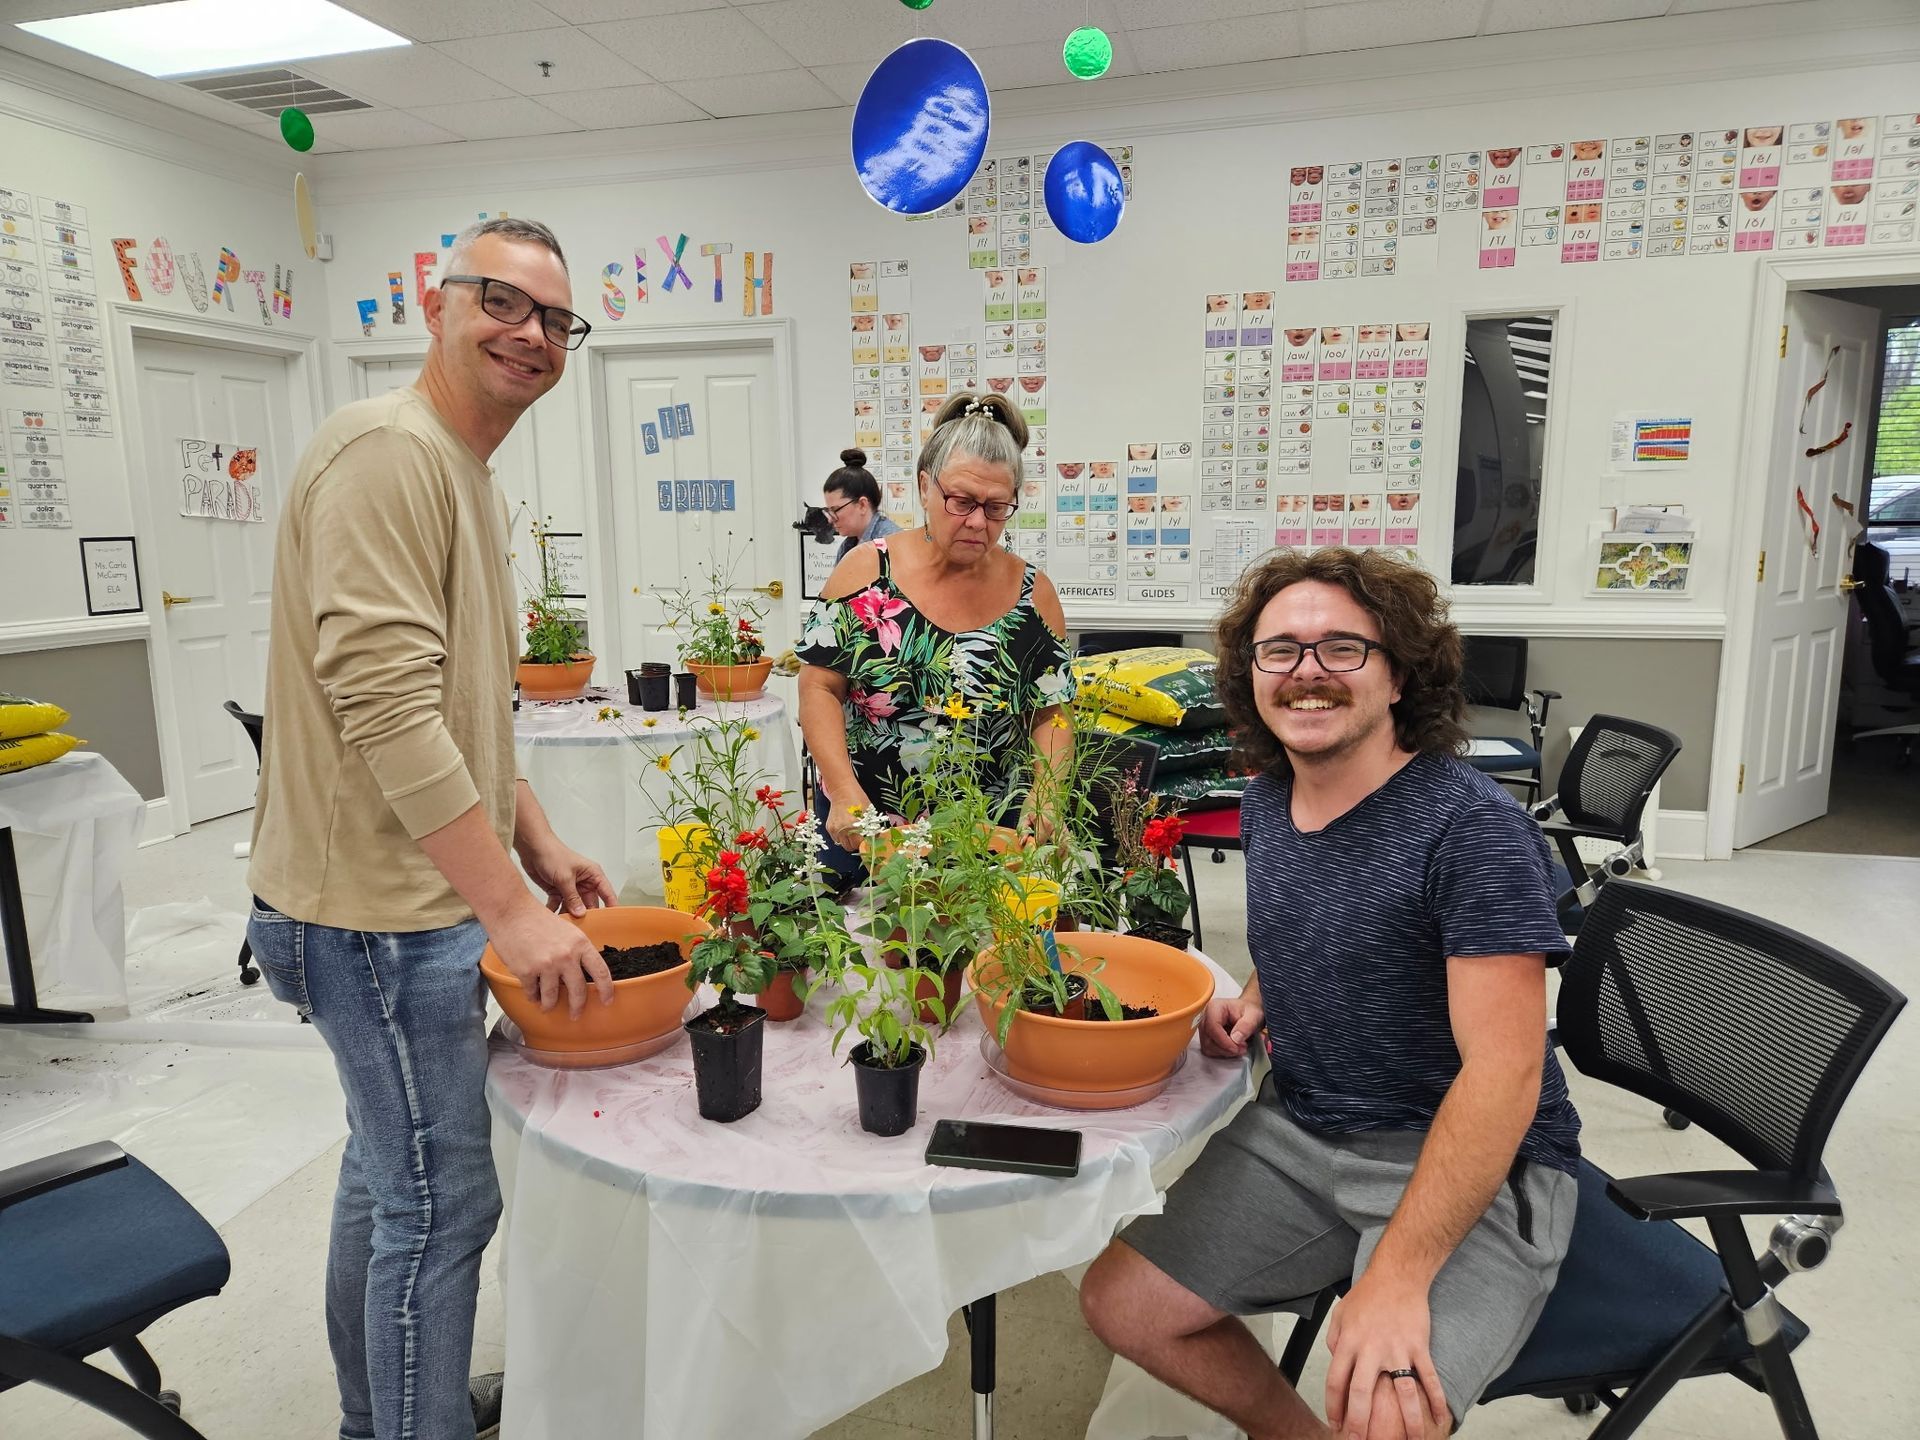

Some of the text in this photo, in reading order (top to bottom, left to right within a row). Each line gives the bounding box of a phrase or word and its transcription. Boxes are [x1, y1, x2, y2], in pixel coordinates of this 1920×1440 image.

[1705, 140, 1717, 148] ey
[1663, 163, 1668, 171] y
[1446, 179, 1464, 189] eigh
[1333, 190, 1341, 198] ai
[1370, 186, 1382, 194] air
[55, 202, 70, 211] data
[1445, 198, 1463, 209] aigh
[1696, 202, 1715, 211] _ost
[1331, 210, 1343, 218] ay
[1038, 216, 1048, 224] ph
[55, 226, 77, 235] column
[1405, 223, 1422, 233] _ind
[1652, 225, 1670, 233] _old
[1692, 243, 1714, 252] ough
[7, 264, 22, 272] hour
[1326, 267, 1343, 278] _igh
[602, 233, 773, 321] SIXTH
[5, 288, 30, 298] minute
[1023, 290, 1039, 299] /sh/
[55, 297, 94, 308] picture graph
[23, 314, 41, 323] clock
[1250, 315, 1264, 324] /r/
[61, 321, 94, 330] pictograph
[2, 336, 44, 347] analog clock
[69, 345, 92, 353] symbol
[1399, 347, 1423, 357] /er/
[1287, 351, 1310, 361] /aw/
[1325, 350, 1346, 359] /oo/
[5, 361, 49, 372] elapsed time
[925, 366, 940, 375] /m/
[68, 368, 82, 376] tally
[83, 392, 102, 400] graph
[1210, 391, 1216, 399] bl
[1244, 390, 1252, 398] br
[643, 406, 691, 453] 6TH
[27, 434, 46, 442] nickel
[182, 439, 223, 472] Pet
[1165, 448, 1176, 456] wh
[1280, 446, 1298, 456] augh
[1131, 465, 1153, 474] /hw/
[1208, 465, 1215, 473] pl
[1280, 464, 1298, 472] ough
[1061, 484, 1080, 492] /ch/
[1098, 483, 1108, 493] /j/
[183, 474, 262, 520] PARADE
[659, 483, 732, 508] GRADE
[1134, 517, 1149, 526] /w/
[1169, 517, 1181, 526] /y/
[1281, 517, 1301, 527] /oy/
[1316, 516, 1338, 525] /ow/
[1353, 517, 1376, 526] /ar/
[1392, 515, 1411, 525] /or/
[109, 561, 127, 569] Carla
[108, 585, 121, 593] ELA
[1141, 590, 1175, 598] GLIDES
